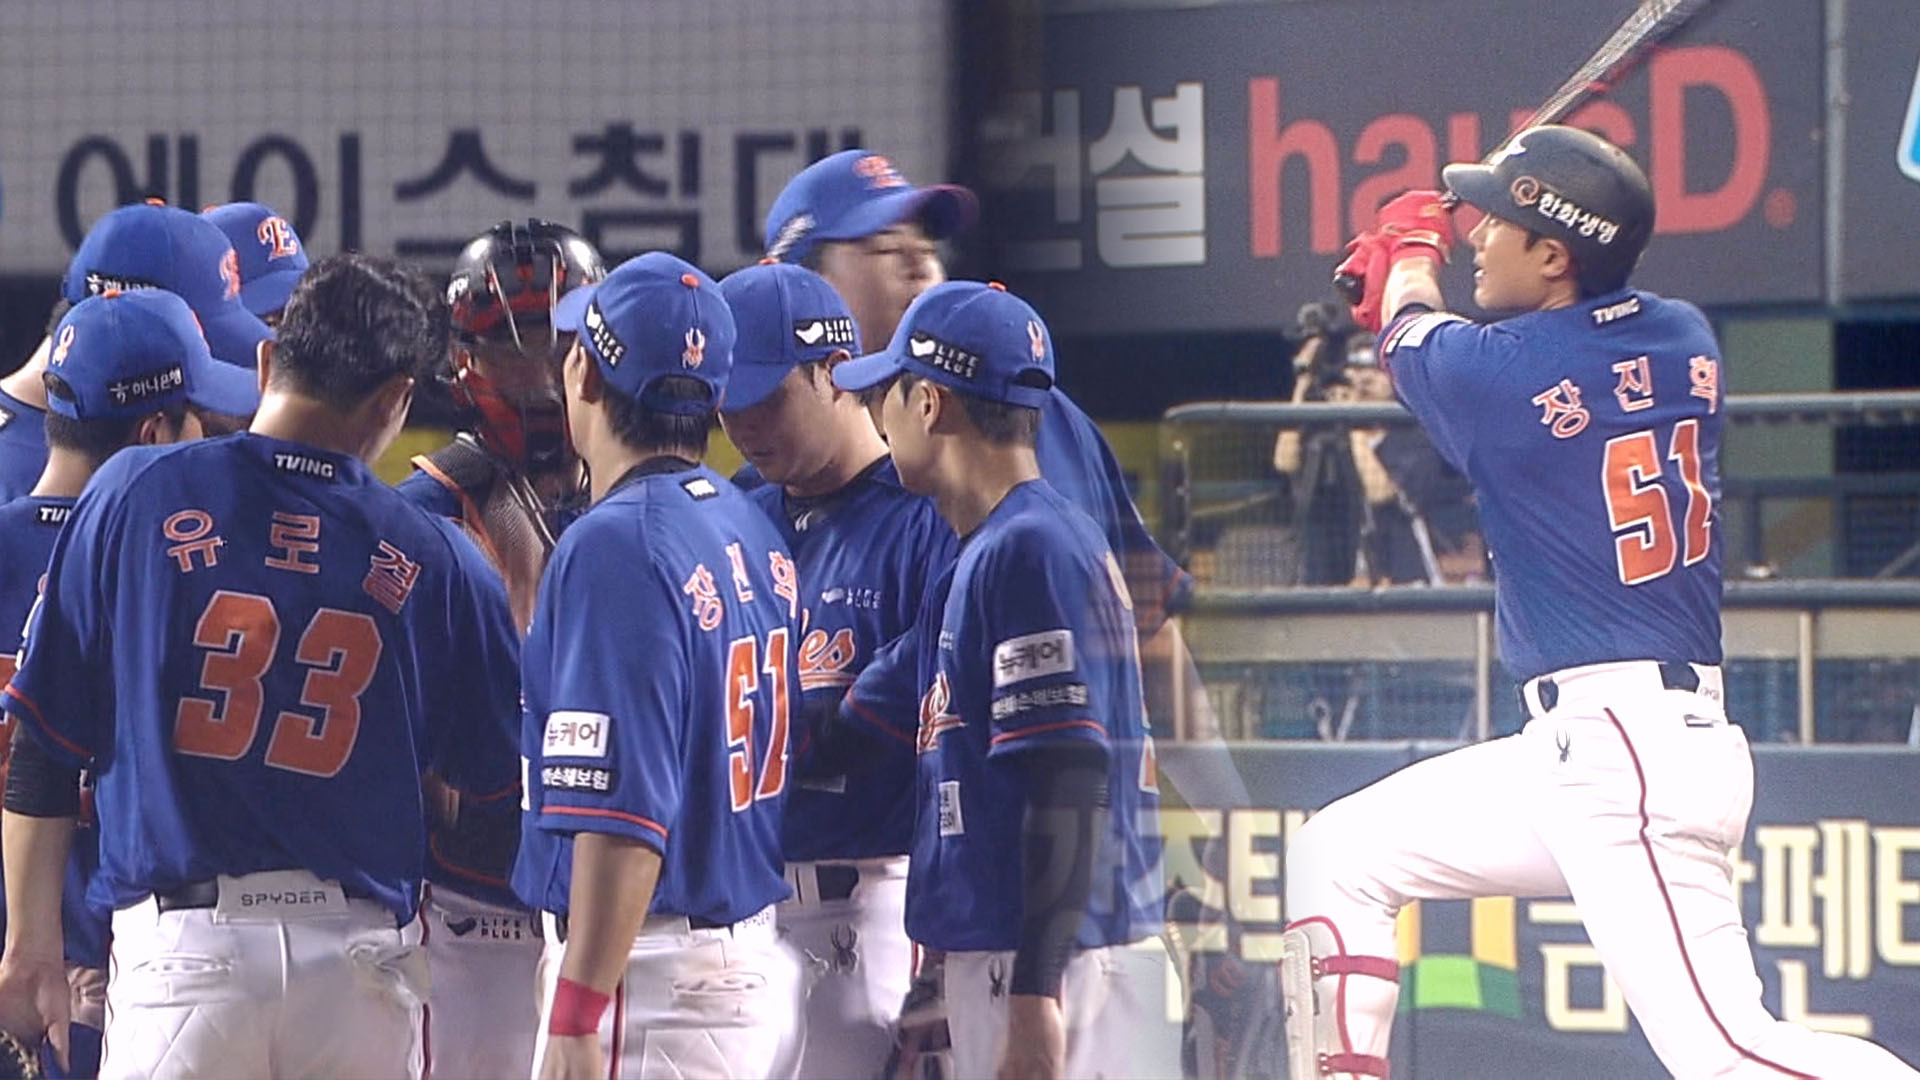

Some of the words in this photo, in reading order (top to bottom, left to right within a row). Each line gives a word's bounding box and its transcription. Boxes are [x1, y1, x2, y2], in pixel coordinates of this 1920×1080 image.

[1538, 192, 1620, 244] 한화생명
[934, 354, 974, 378] PLUS
[938, 343, 979, 368] LIFE
[274, 453, 333, 478] TVING
[1601, 418, 1712, 586] 51
[173, 590, 383, 779] 33
[726, 623, 789, 813] 51
[547, 720, 602, 749] 뉴케어
[241, 891, 327, 907] SPYDER
[481, 918, 522, 929] LIFE
[481, 930, 521, 940] PLUS
